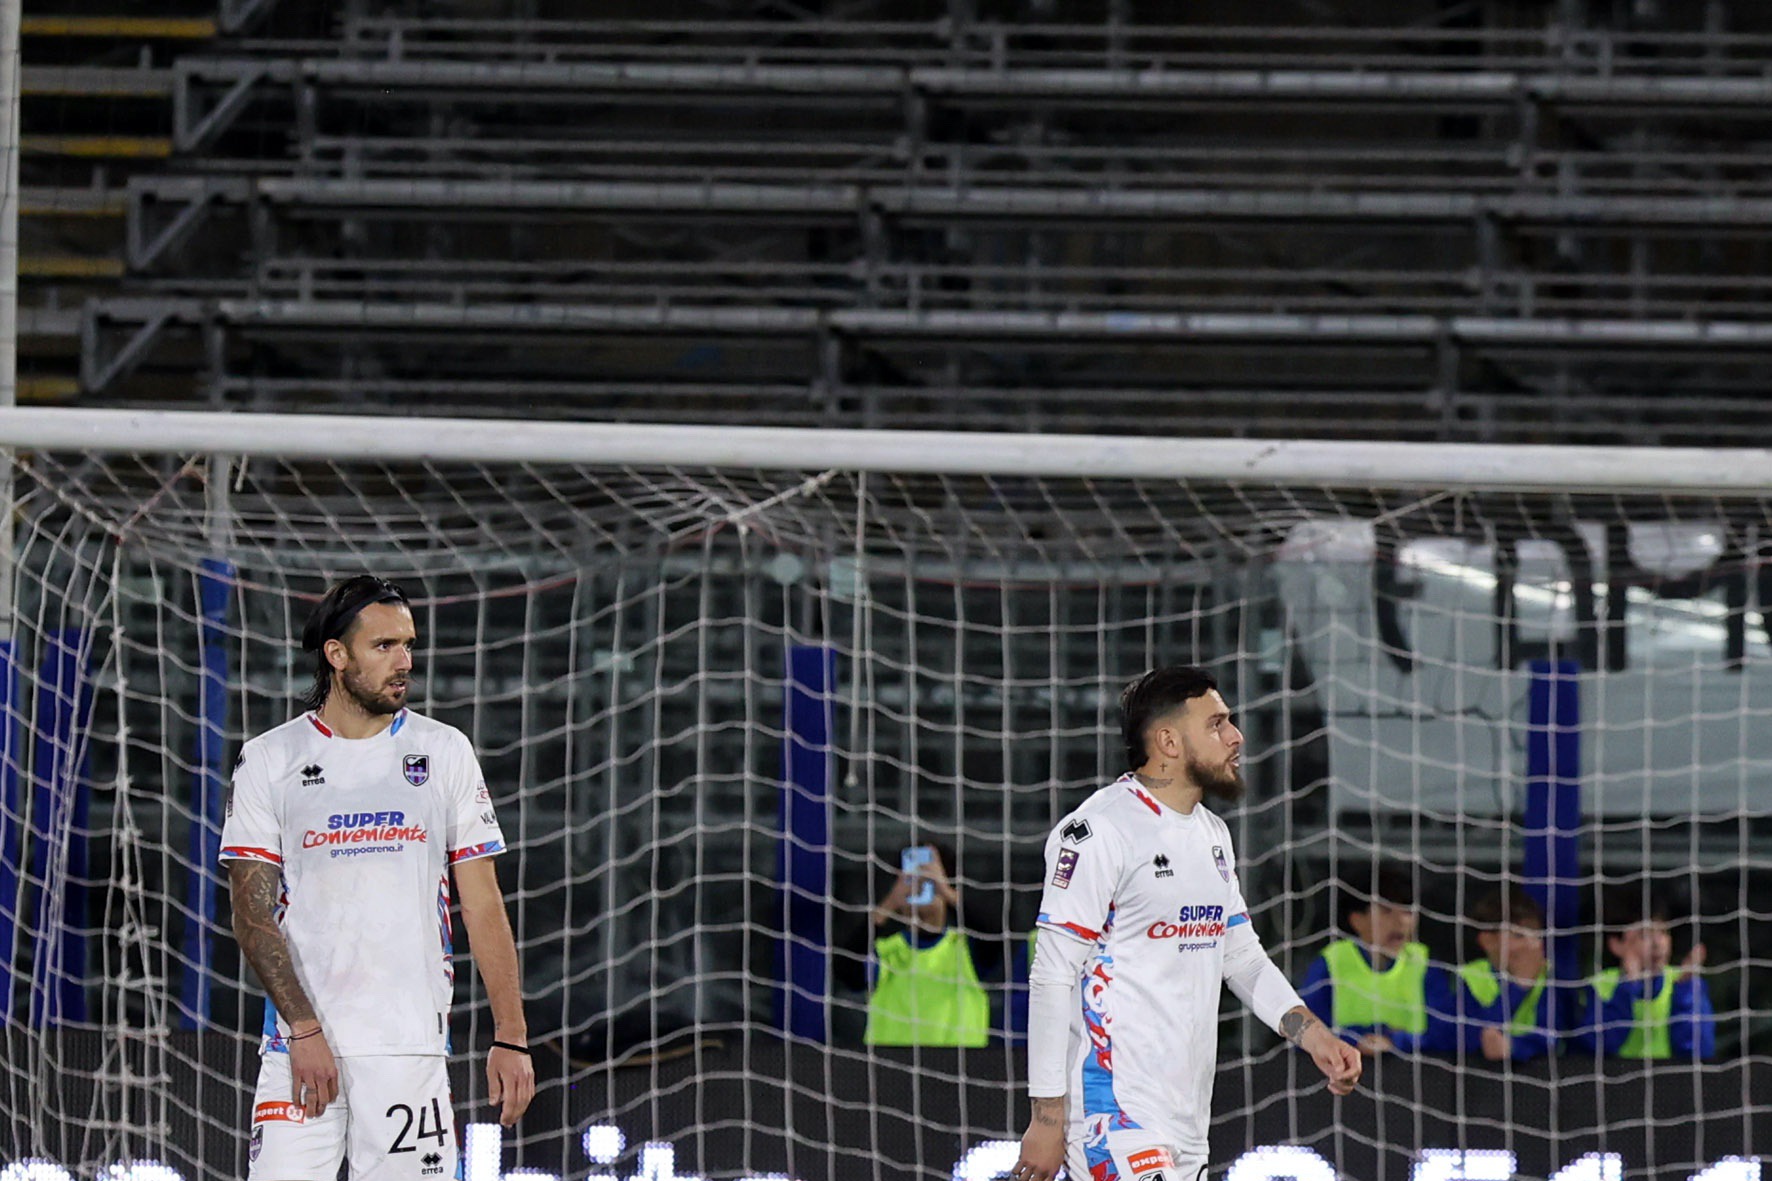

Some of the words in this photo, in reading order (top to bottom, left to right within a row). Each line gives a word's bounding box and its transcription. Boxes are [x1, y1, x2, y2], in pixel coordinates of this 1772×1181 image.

[328, 811, 405, 829] SUPER
[302, 824, 427, 848] Conveniente
[331, 844, 404, 858] gruppoarena.it
[1179, 905, 1223, 922] SUPER
[386, 1097, 448, 1154] 24
